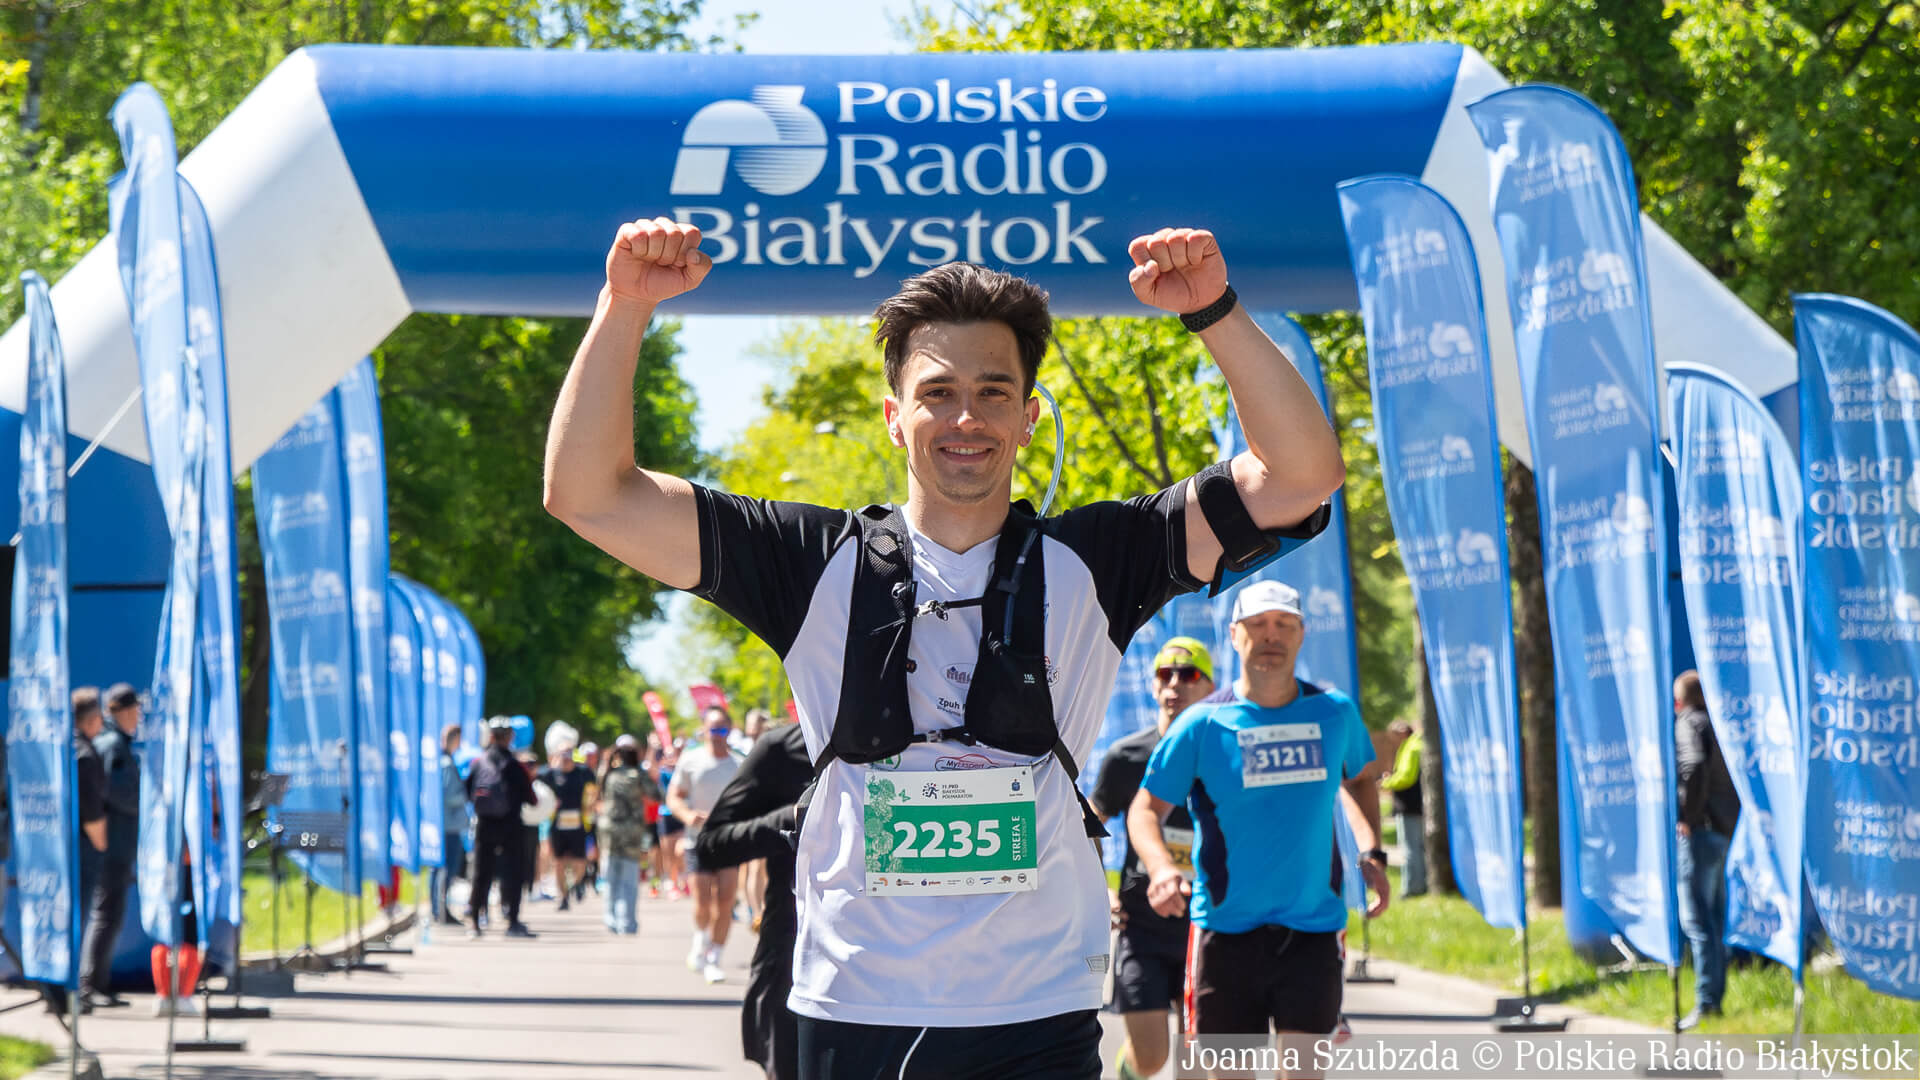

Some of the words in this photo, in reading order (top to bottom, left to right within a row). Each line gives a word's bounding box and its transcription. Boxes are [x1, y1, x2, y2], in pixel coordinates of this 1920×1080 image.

[836, 78, 1108, 123] Polskie
[836, 128, 1108, 196] Radio
[672, 200, 1108, 278] Białystok
[1256, 745, 1308, 769] 3121
[893, 819, 1001, 859] 2235
[1011, 823, 1022, 861] STREFA
